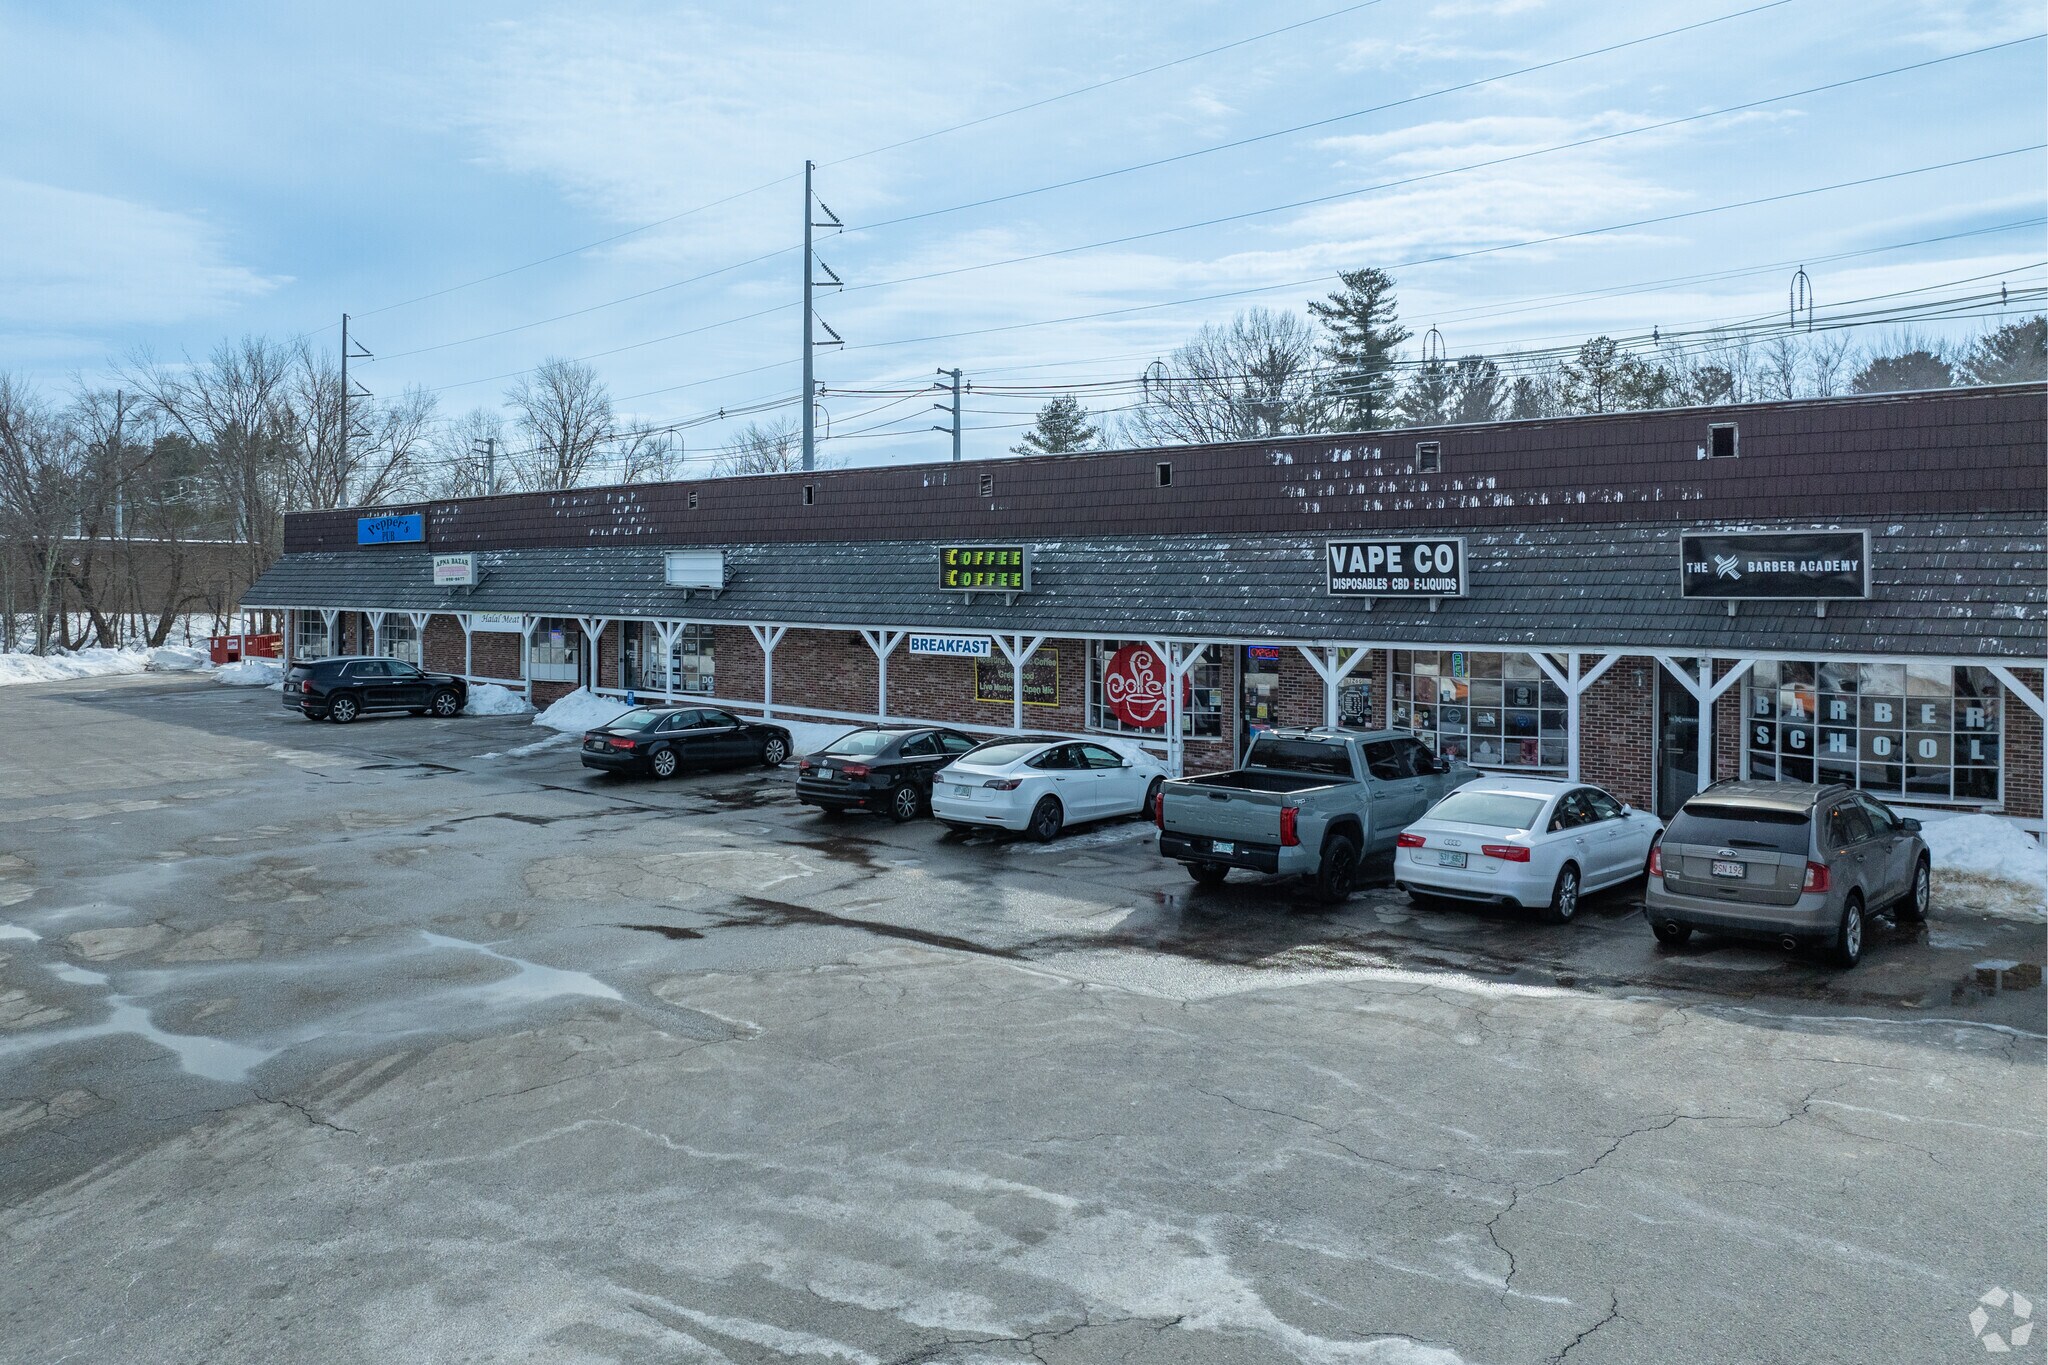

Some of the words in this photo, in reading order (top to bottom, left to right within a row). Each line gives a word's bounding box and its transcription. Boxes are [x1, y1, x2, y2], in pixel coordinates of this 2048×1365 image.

[367, 518, 410, 535] Pepper's
[436, 559, 450, 567] APNA
[451, 557, 469, 566] BAZAR
[945, 548, 1021, 565] COFFEE
[1330, 545, 1403, 573] VAPE
[1413, 544, 1454, 573] CO
[1686, 562, 1709, 573] THE
[1747, 561, 1796, 572] BARBER
[1799, 559, 1859, 572] ACADEMY
[945, 569, 1021, 586] COFFEE
[1333, 578, 1388, 590] DISPOSABLES
[1391, 578, 1410, 590] CBD
[1413, 578, 1457, 591] E-LIQUIDS
[481, 613, 501, 623] Halal
[501, 615, 520, 624] Meat
[911, 637, 989, 653] BREAKFAST
[1250, 648, 1279, 657] OPEN
[1034, 657, 1057, 667] Coffee
[980, 682, 993, 690] Live
[994, 683, 1013, 692] Music
[1023, 684, 1041, 695] Open
[1756, 696, 1985, 728] BARBER
[1756, 725, 1985, 760] SCHOOL
